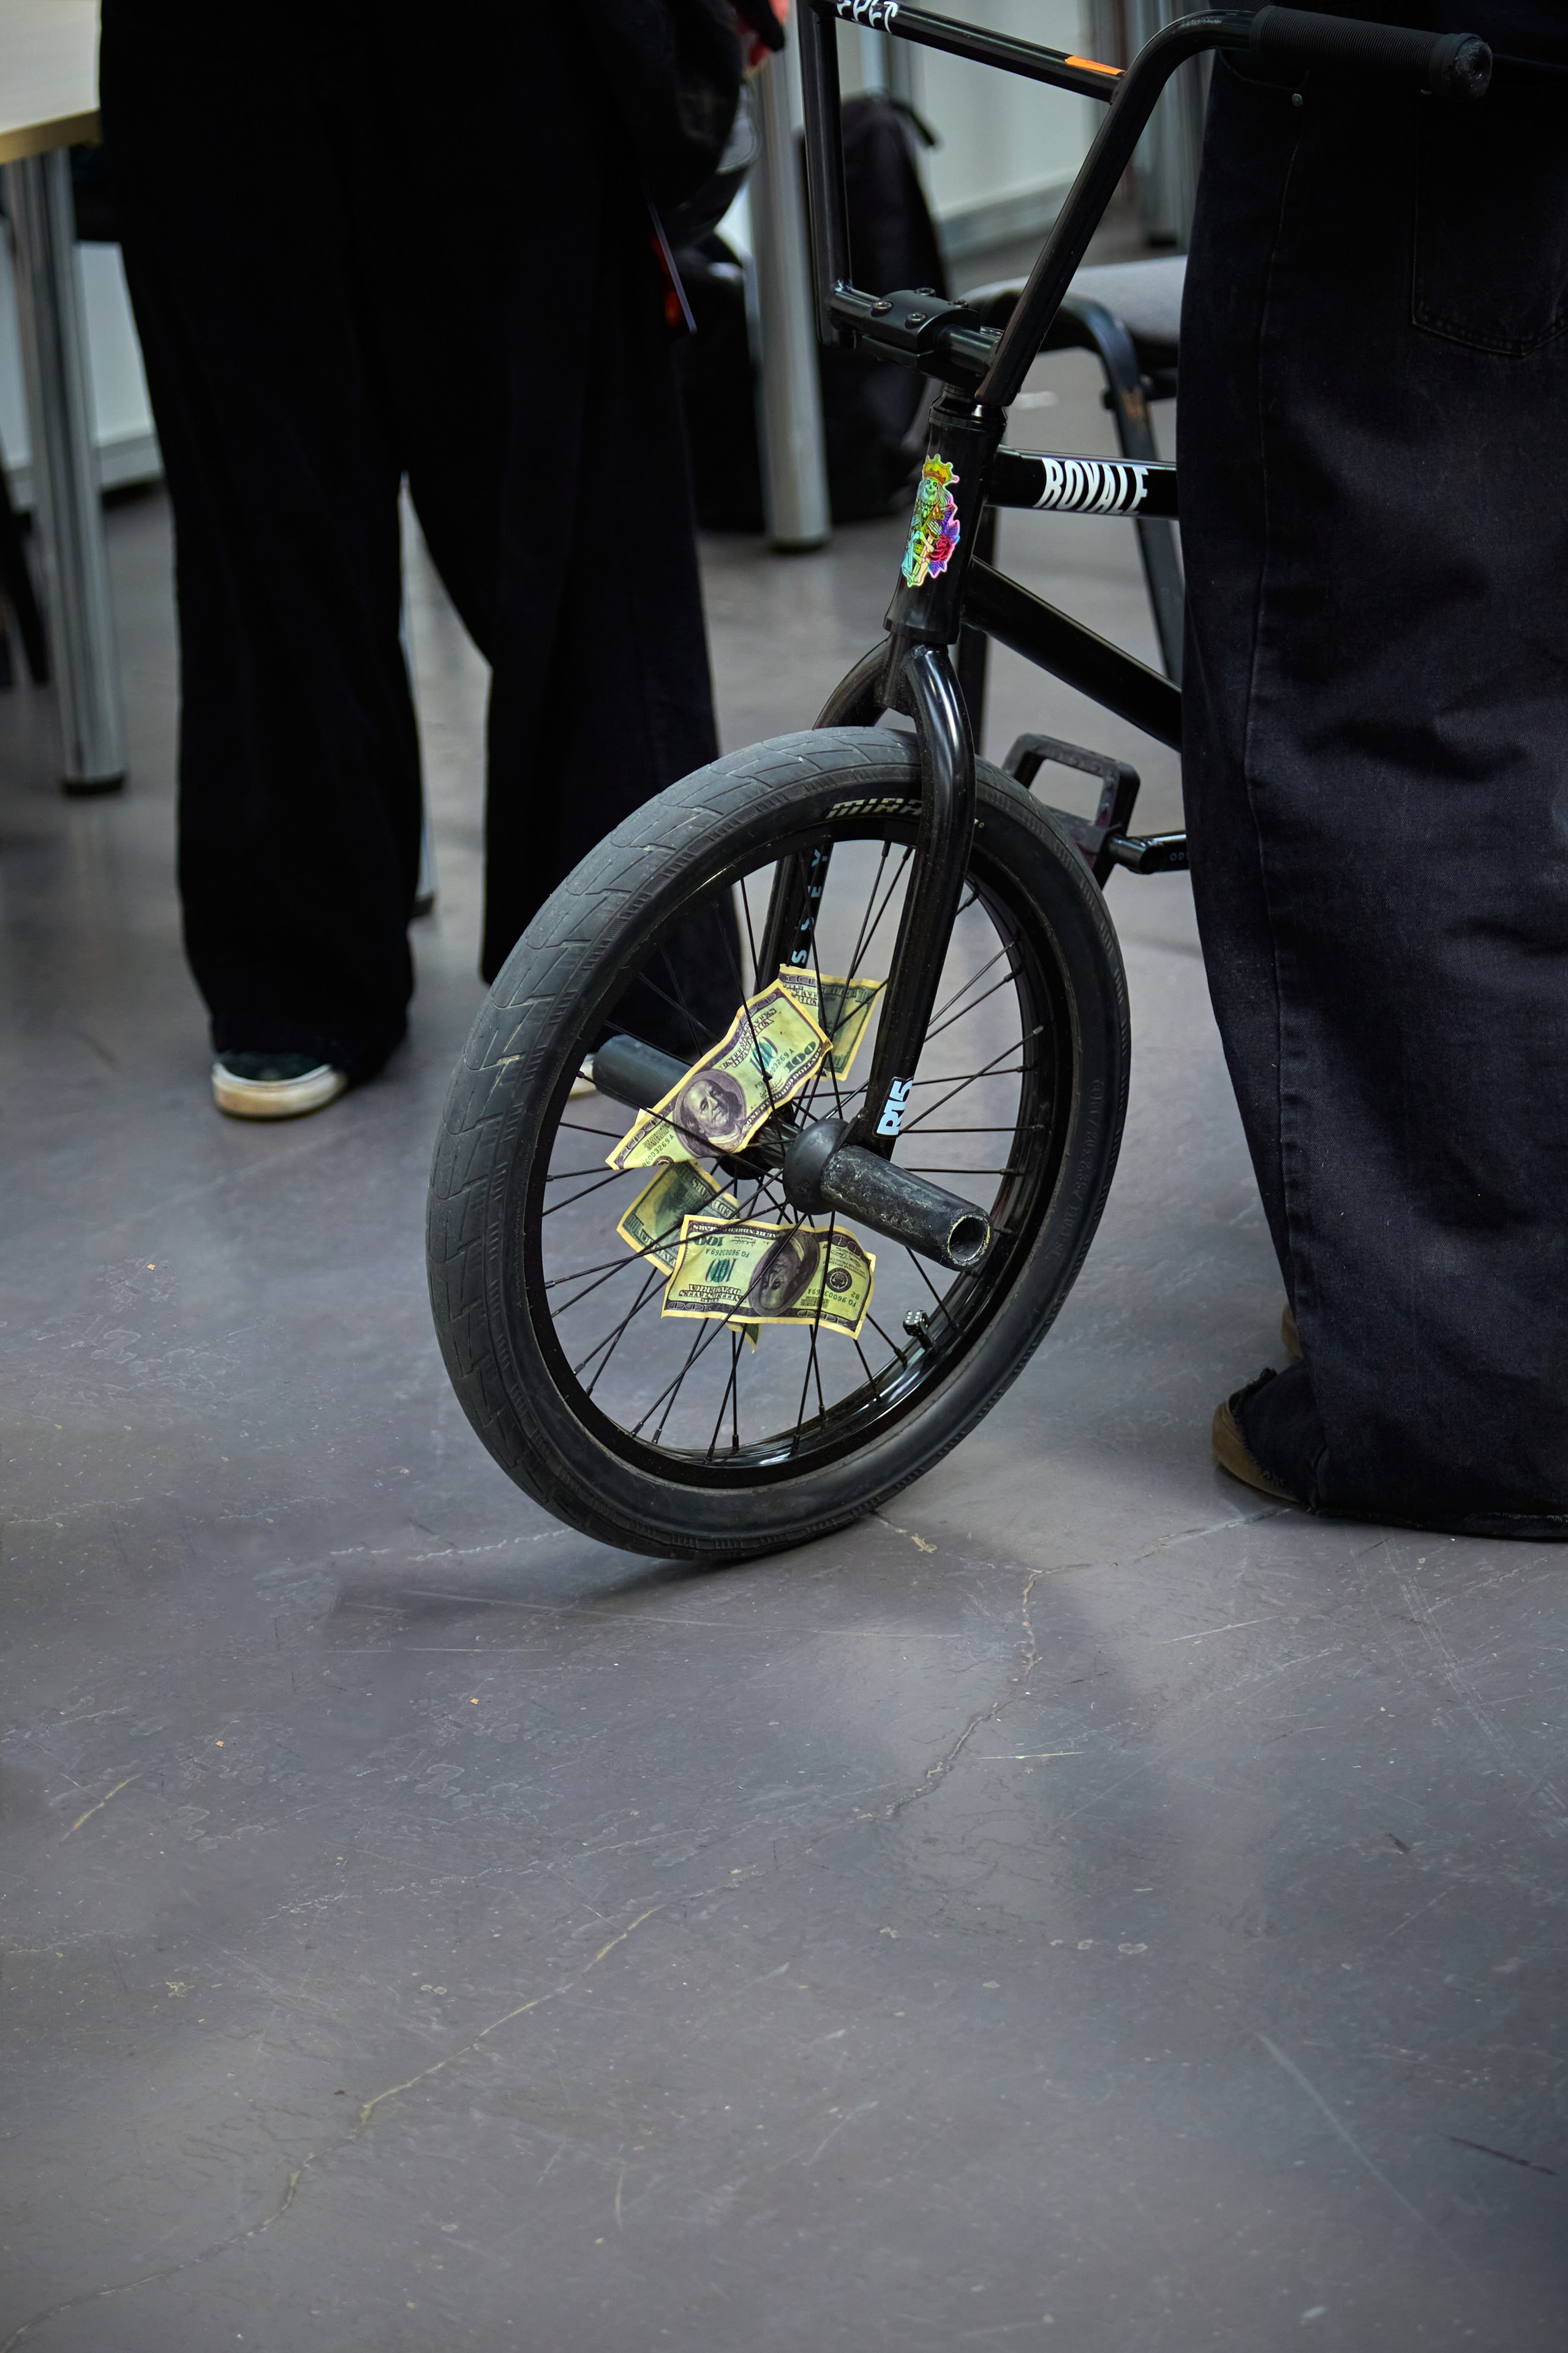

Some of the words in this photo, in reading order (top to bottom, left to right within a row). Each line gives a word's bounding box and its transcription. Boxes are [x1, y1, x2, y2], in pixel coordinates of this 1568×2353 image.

[1032, 457, 1149, 515] ROYALE
[783, 1041, 816, 1074] 100
[692, 1236, 725, 1247] 100
[705, 1257, 739, 1283] 100
[812, 1288, 848, 1302] 9600369
[848, 1297, 857, 1307] FG
[851, 1291, 860, 1300] B2
